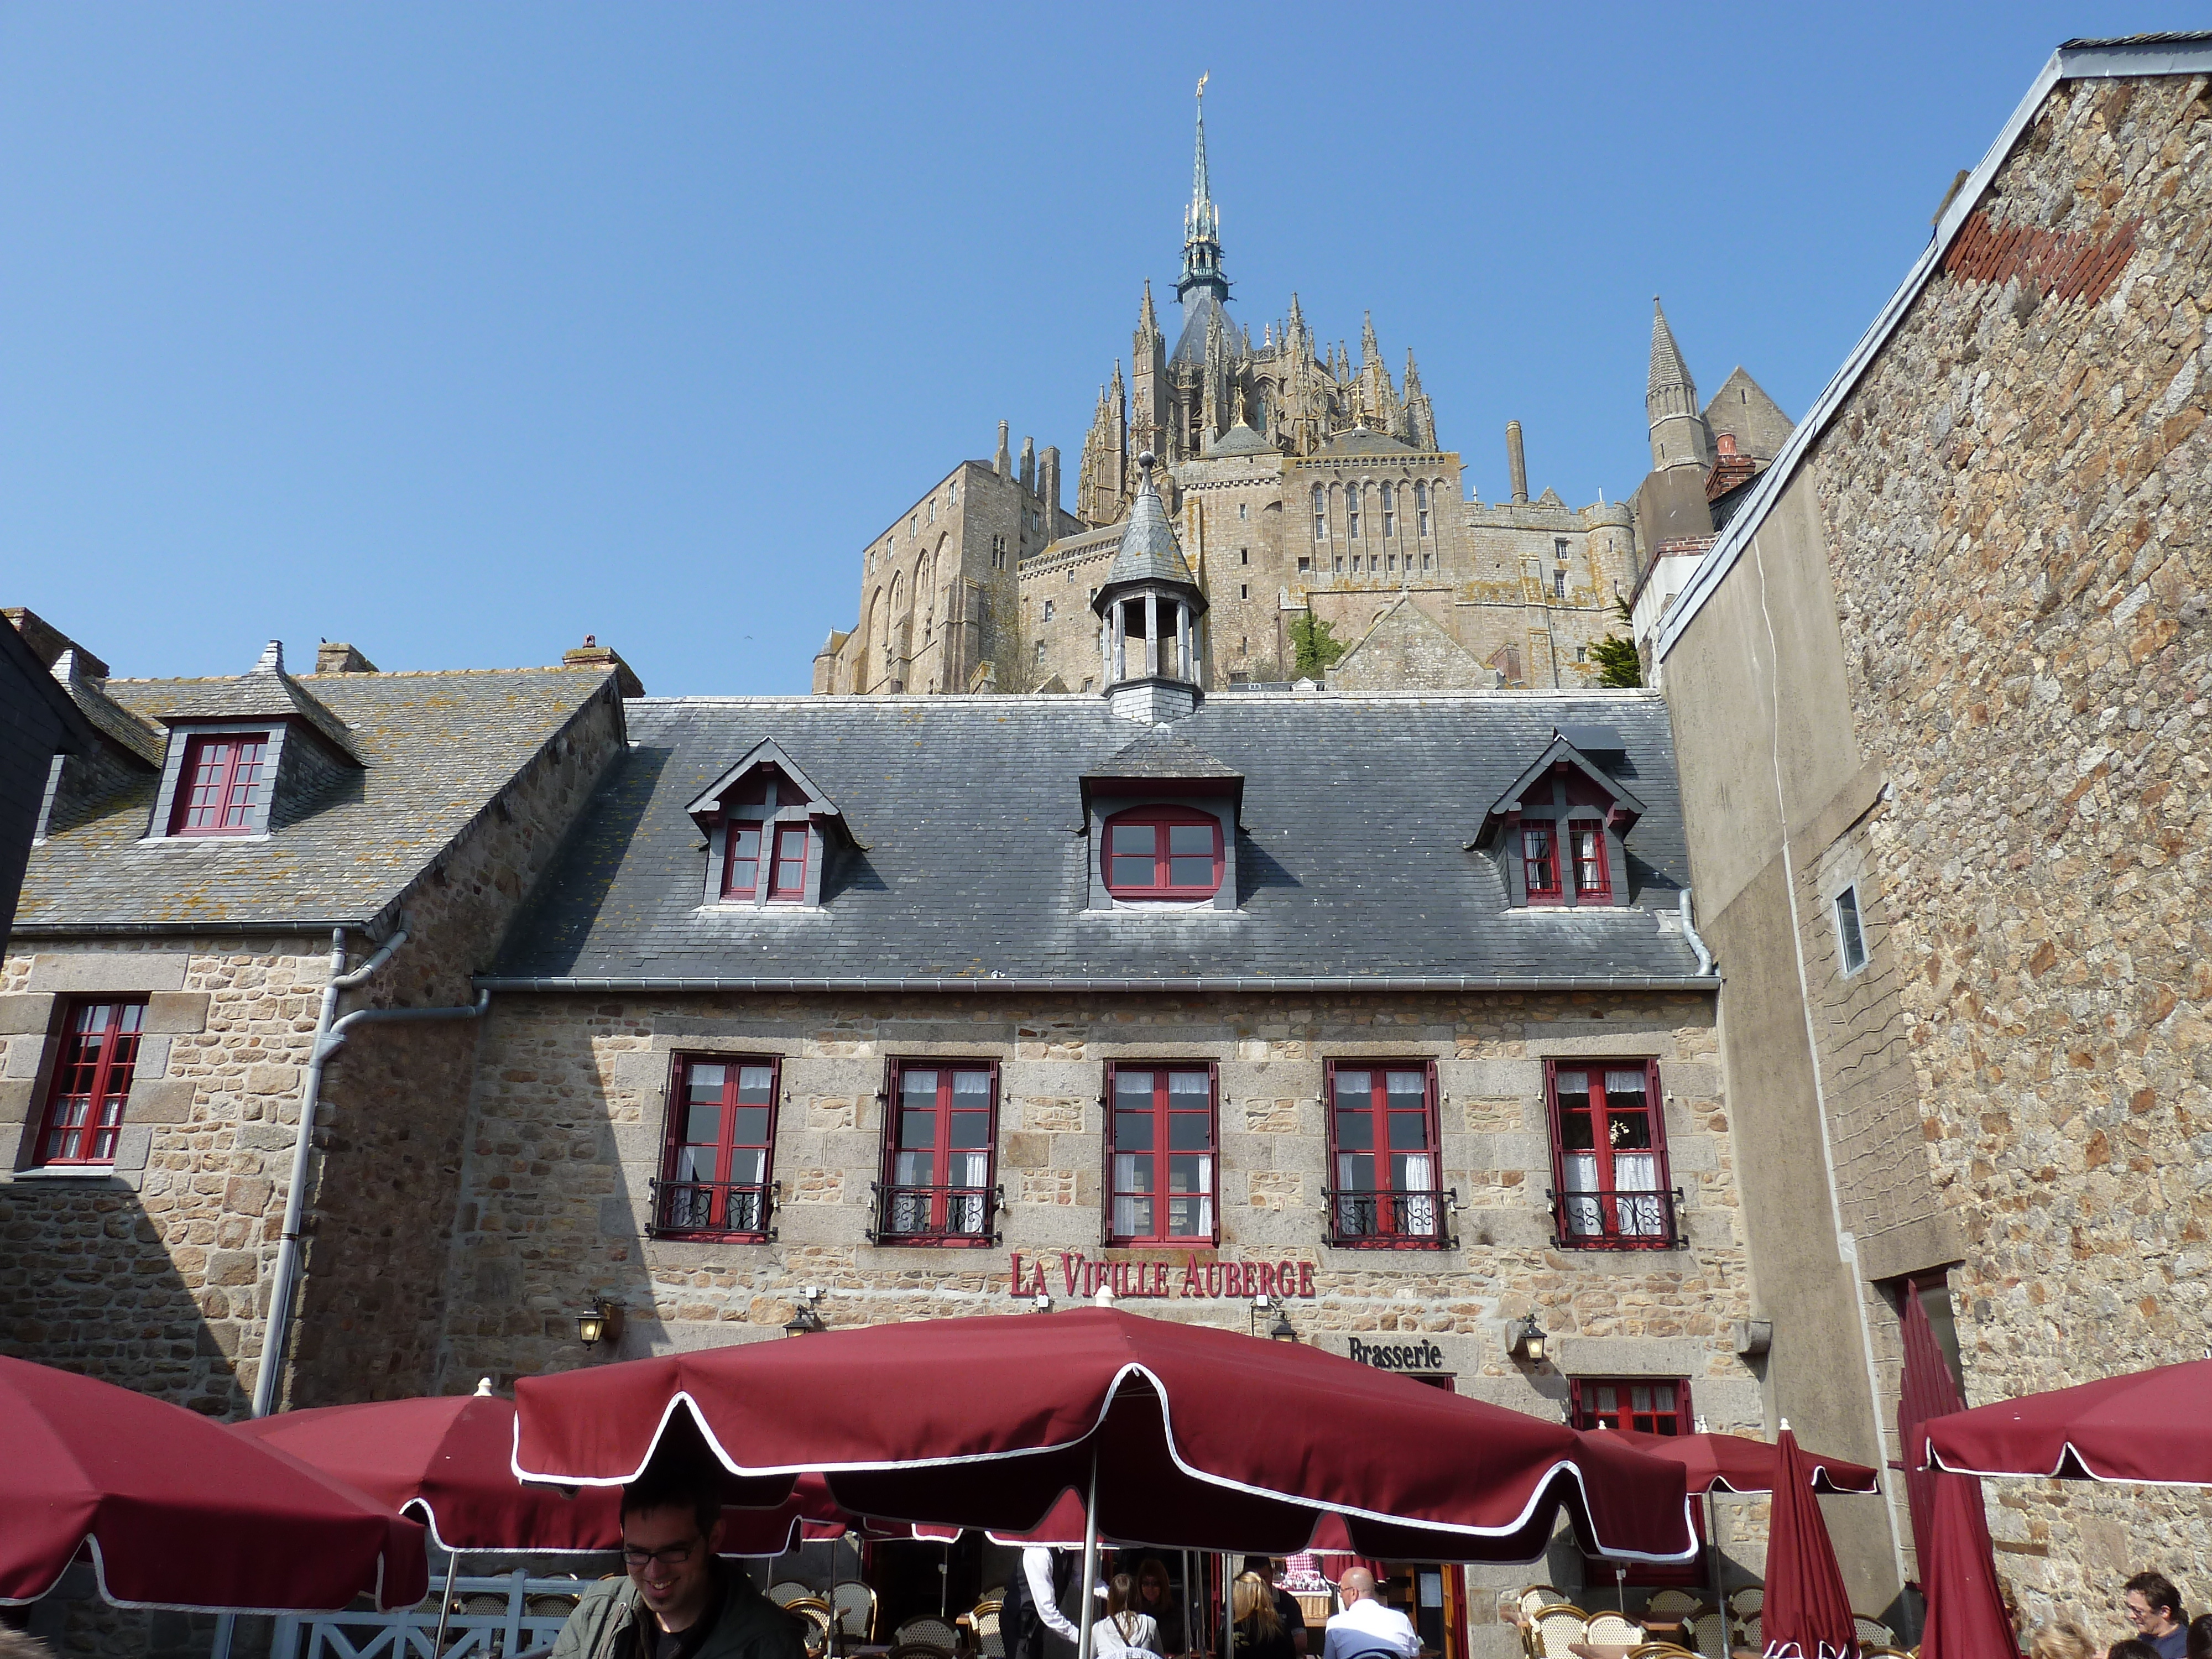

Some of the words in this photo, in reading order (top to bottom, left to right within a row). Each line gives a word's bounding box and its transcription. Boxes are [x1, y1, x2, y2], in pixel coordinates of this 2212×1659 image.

[1009, 1253, 1048, 1296] LA
[1060, 1253, 1170, 1296] VIEILLE
[1180, 1253, 1316, 1297] AUBERGE
[1348, 1337, 1443, 1369] Brasserie
